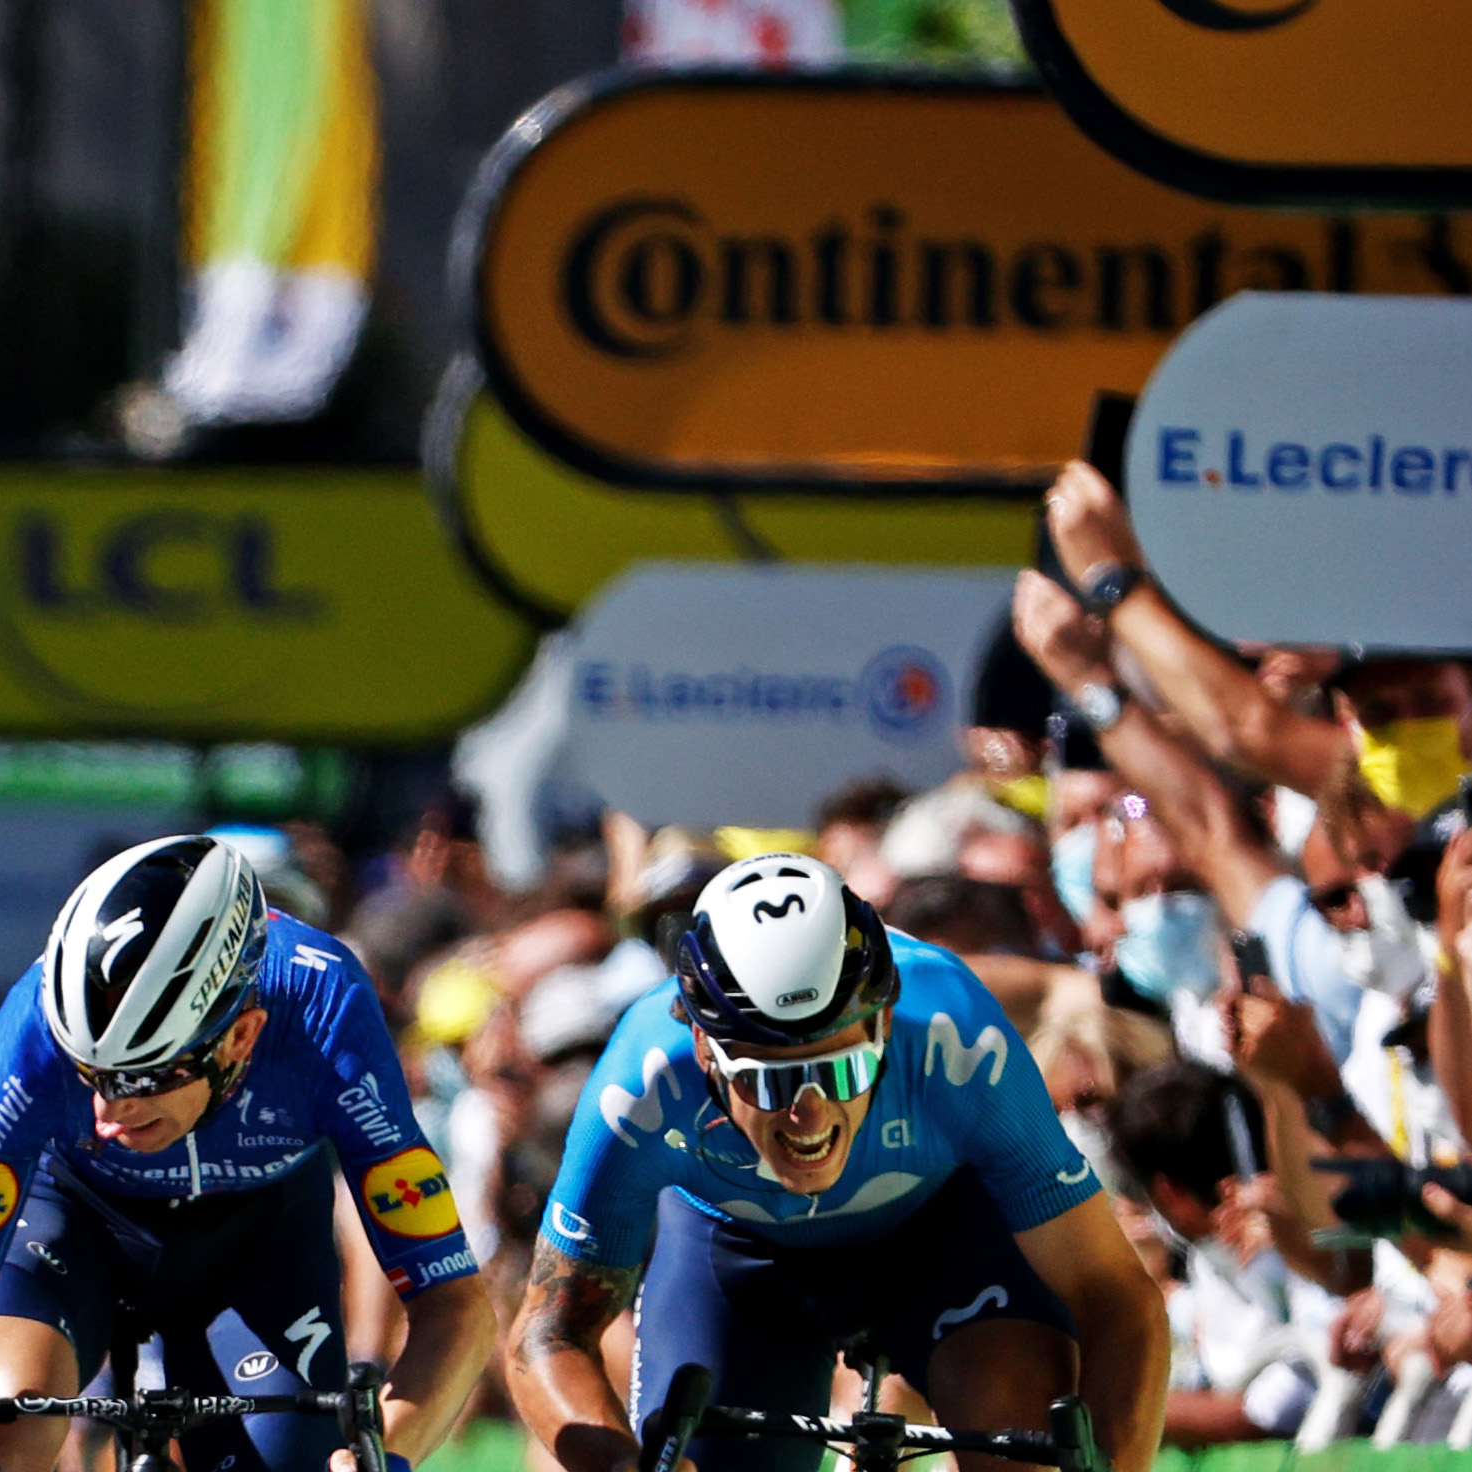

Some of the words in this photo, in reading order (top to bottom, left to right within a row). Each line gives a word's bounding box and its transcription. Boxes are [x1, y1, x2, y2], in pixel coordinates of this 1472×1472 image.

[1157, 425, 1472, 497] E.Lecler
[18, 508, 320, 624] LCL
[238, 1132, 304, 1148] latexco
[337, 1086, 403, 1147] crivit
